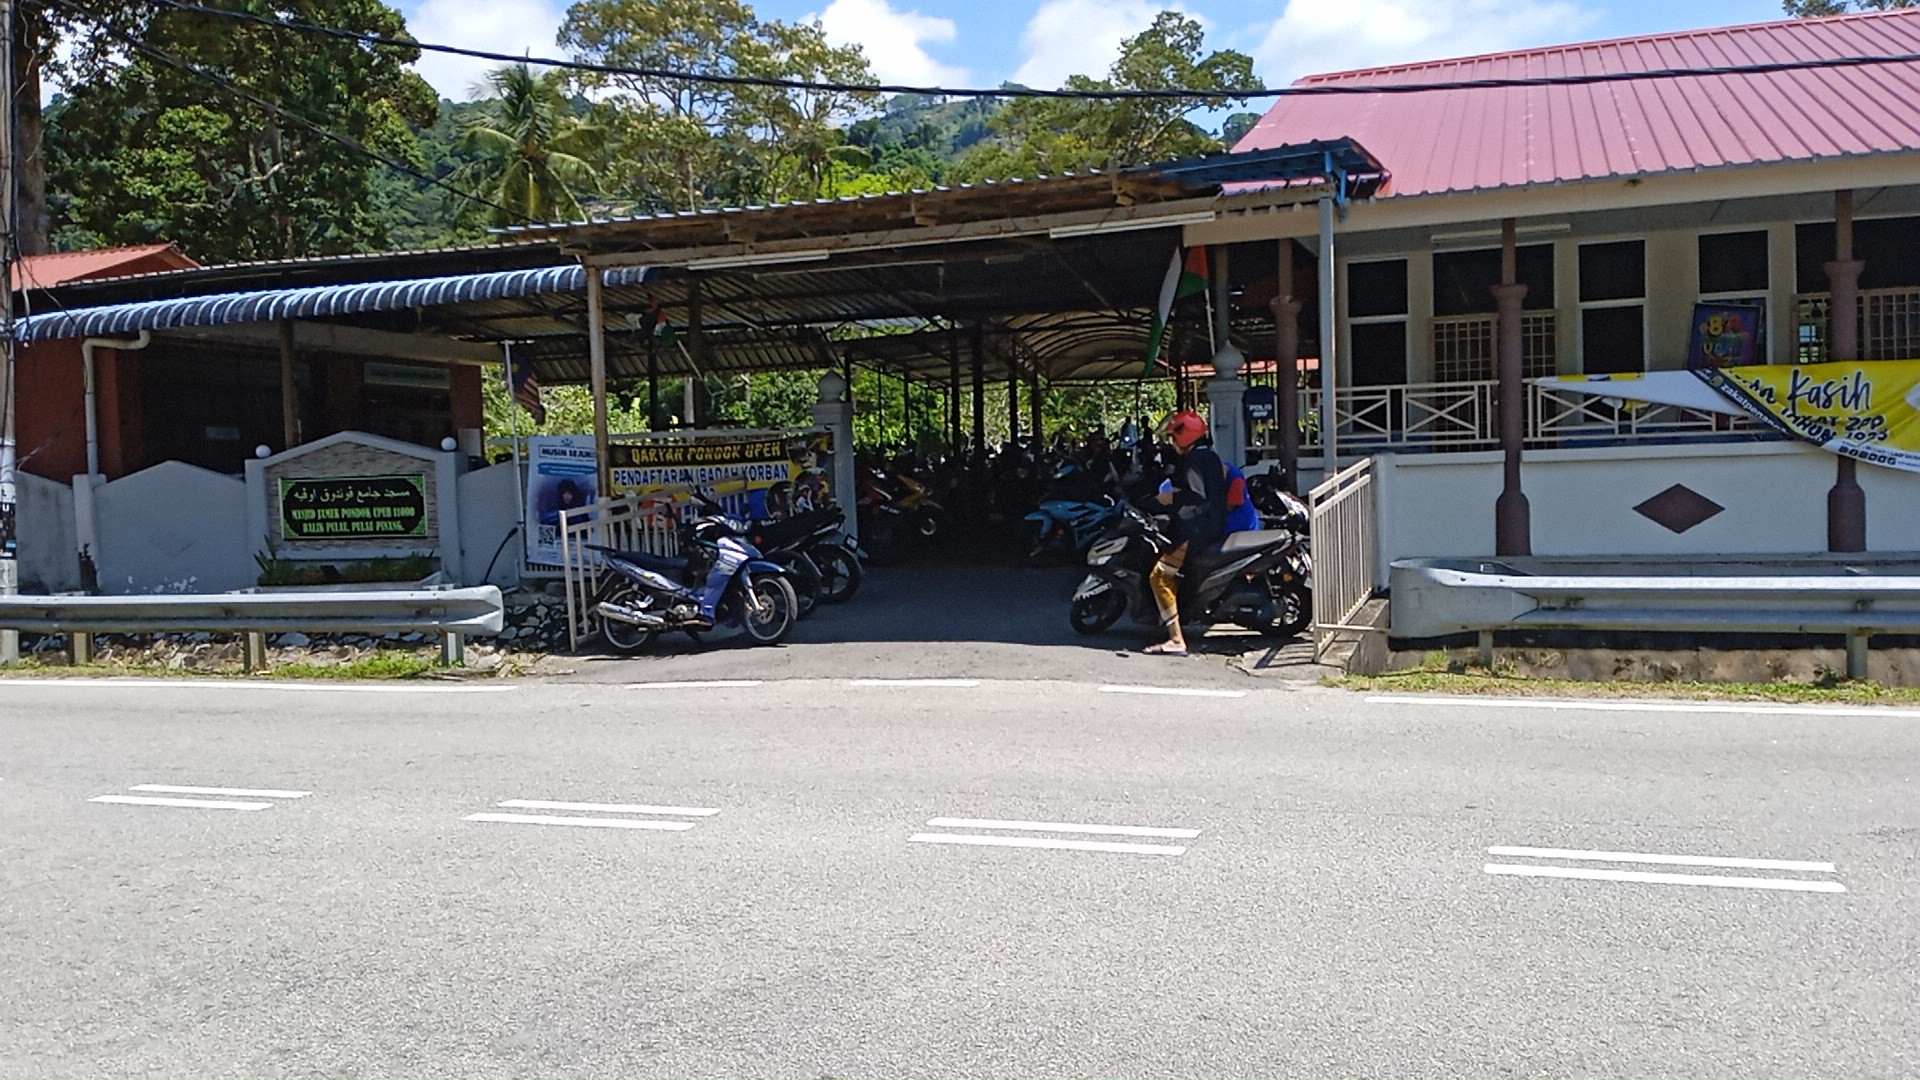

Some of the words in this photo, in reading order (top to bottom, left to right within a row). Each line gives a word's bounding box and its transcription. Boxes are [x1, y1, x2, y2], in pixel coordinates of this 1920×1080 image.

[1787, 369, 1872, 415] Kasih
[631, 447, 683, 465] QARYAH
[686, 445, 741, 462] PONDOK
[745, 441, 781, 459] UPEH
[613, 468, 694, 486] PENDAFTARAN
[742, 463, 789, 482] KORBAN
[341, 507, 371, 518] PONDOK
